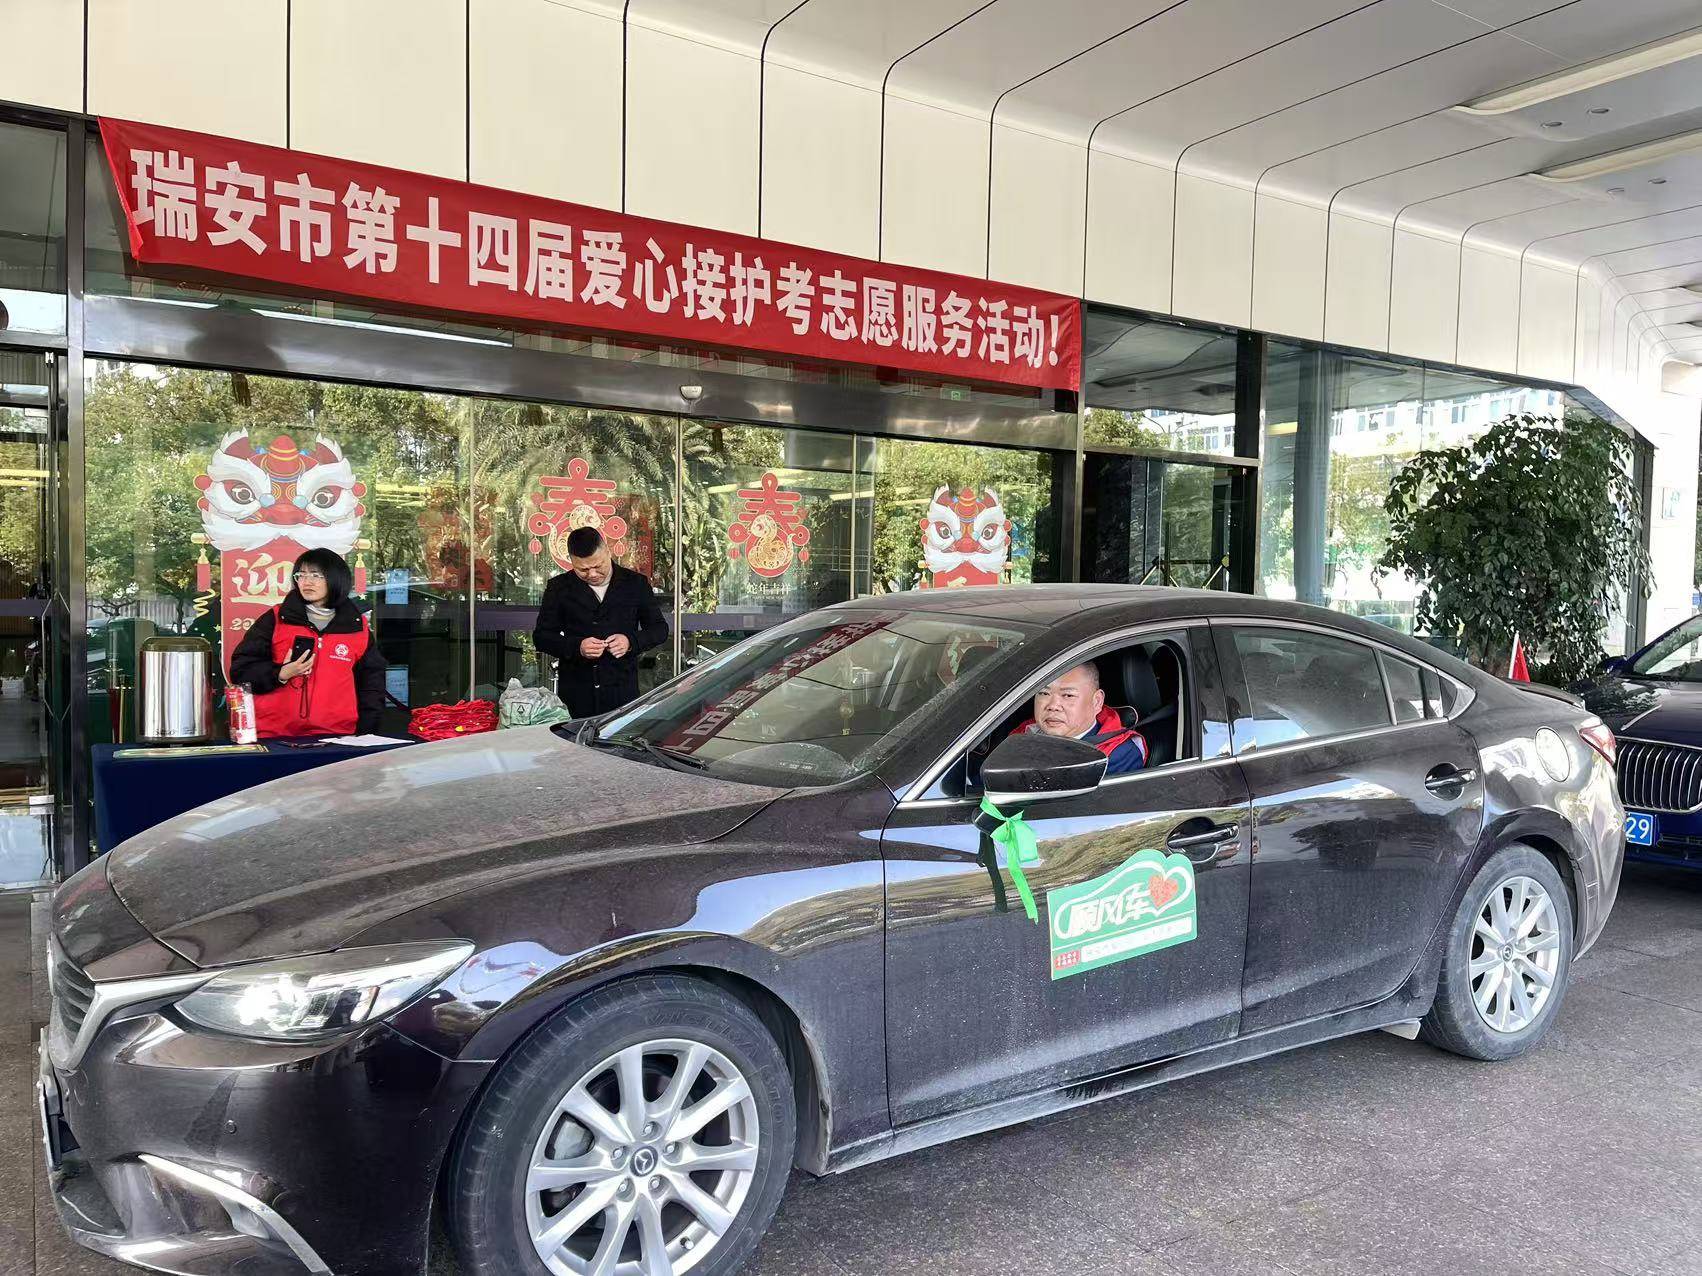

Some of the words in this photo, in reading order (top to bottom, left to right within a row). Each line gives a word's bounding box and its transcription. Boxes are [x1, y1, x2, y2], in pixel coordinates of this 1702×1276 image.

[129, 148, 1060, 369] 瑞安市第十四届爱心接护考志愿服务活动!
[230, 552, 296, 606] 迎
[230, 617, 256, 631] 20
